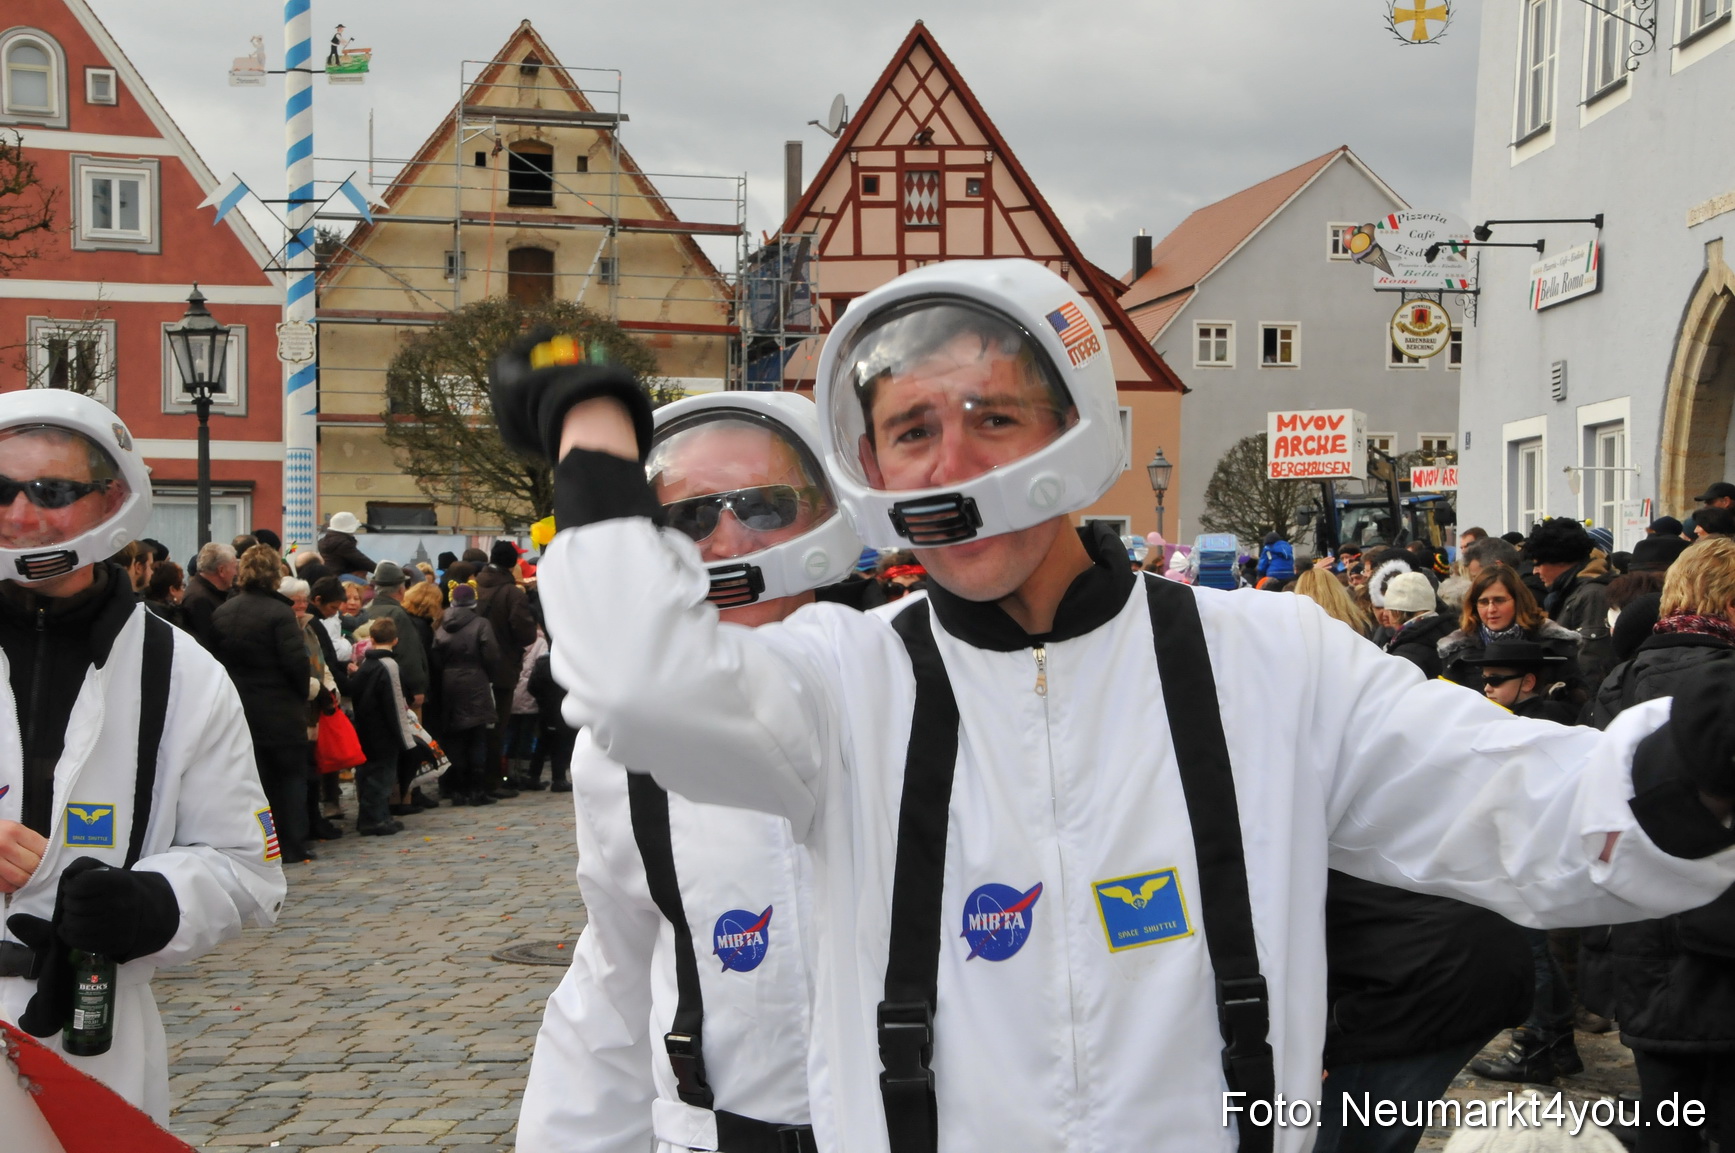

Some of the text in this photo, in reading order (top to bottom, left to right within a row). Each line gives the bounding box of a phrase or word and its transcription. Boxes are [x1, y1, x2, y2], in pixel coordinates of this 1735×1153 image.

[1397, 211, 1448, 224] Pizzeria
[1409, 229, 1436, 241] Café
[1378, 276, 1418, 285] Roma
[1403, 269, 1440, 278] Bella
[1540, 271, 1585, 302] Bella Roma
[1276, 413, 1346, 433] MVOV
[1273, 434, 1348, 459] ARCHE
[968, 911, 1026, 931] MIRTA
[1117, 920, 1178, 940] SPACE SHUTTLE
[716, 931, 764, 950] MIRTA
